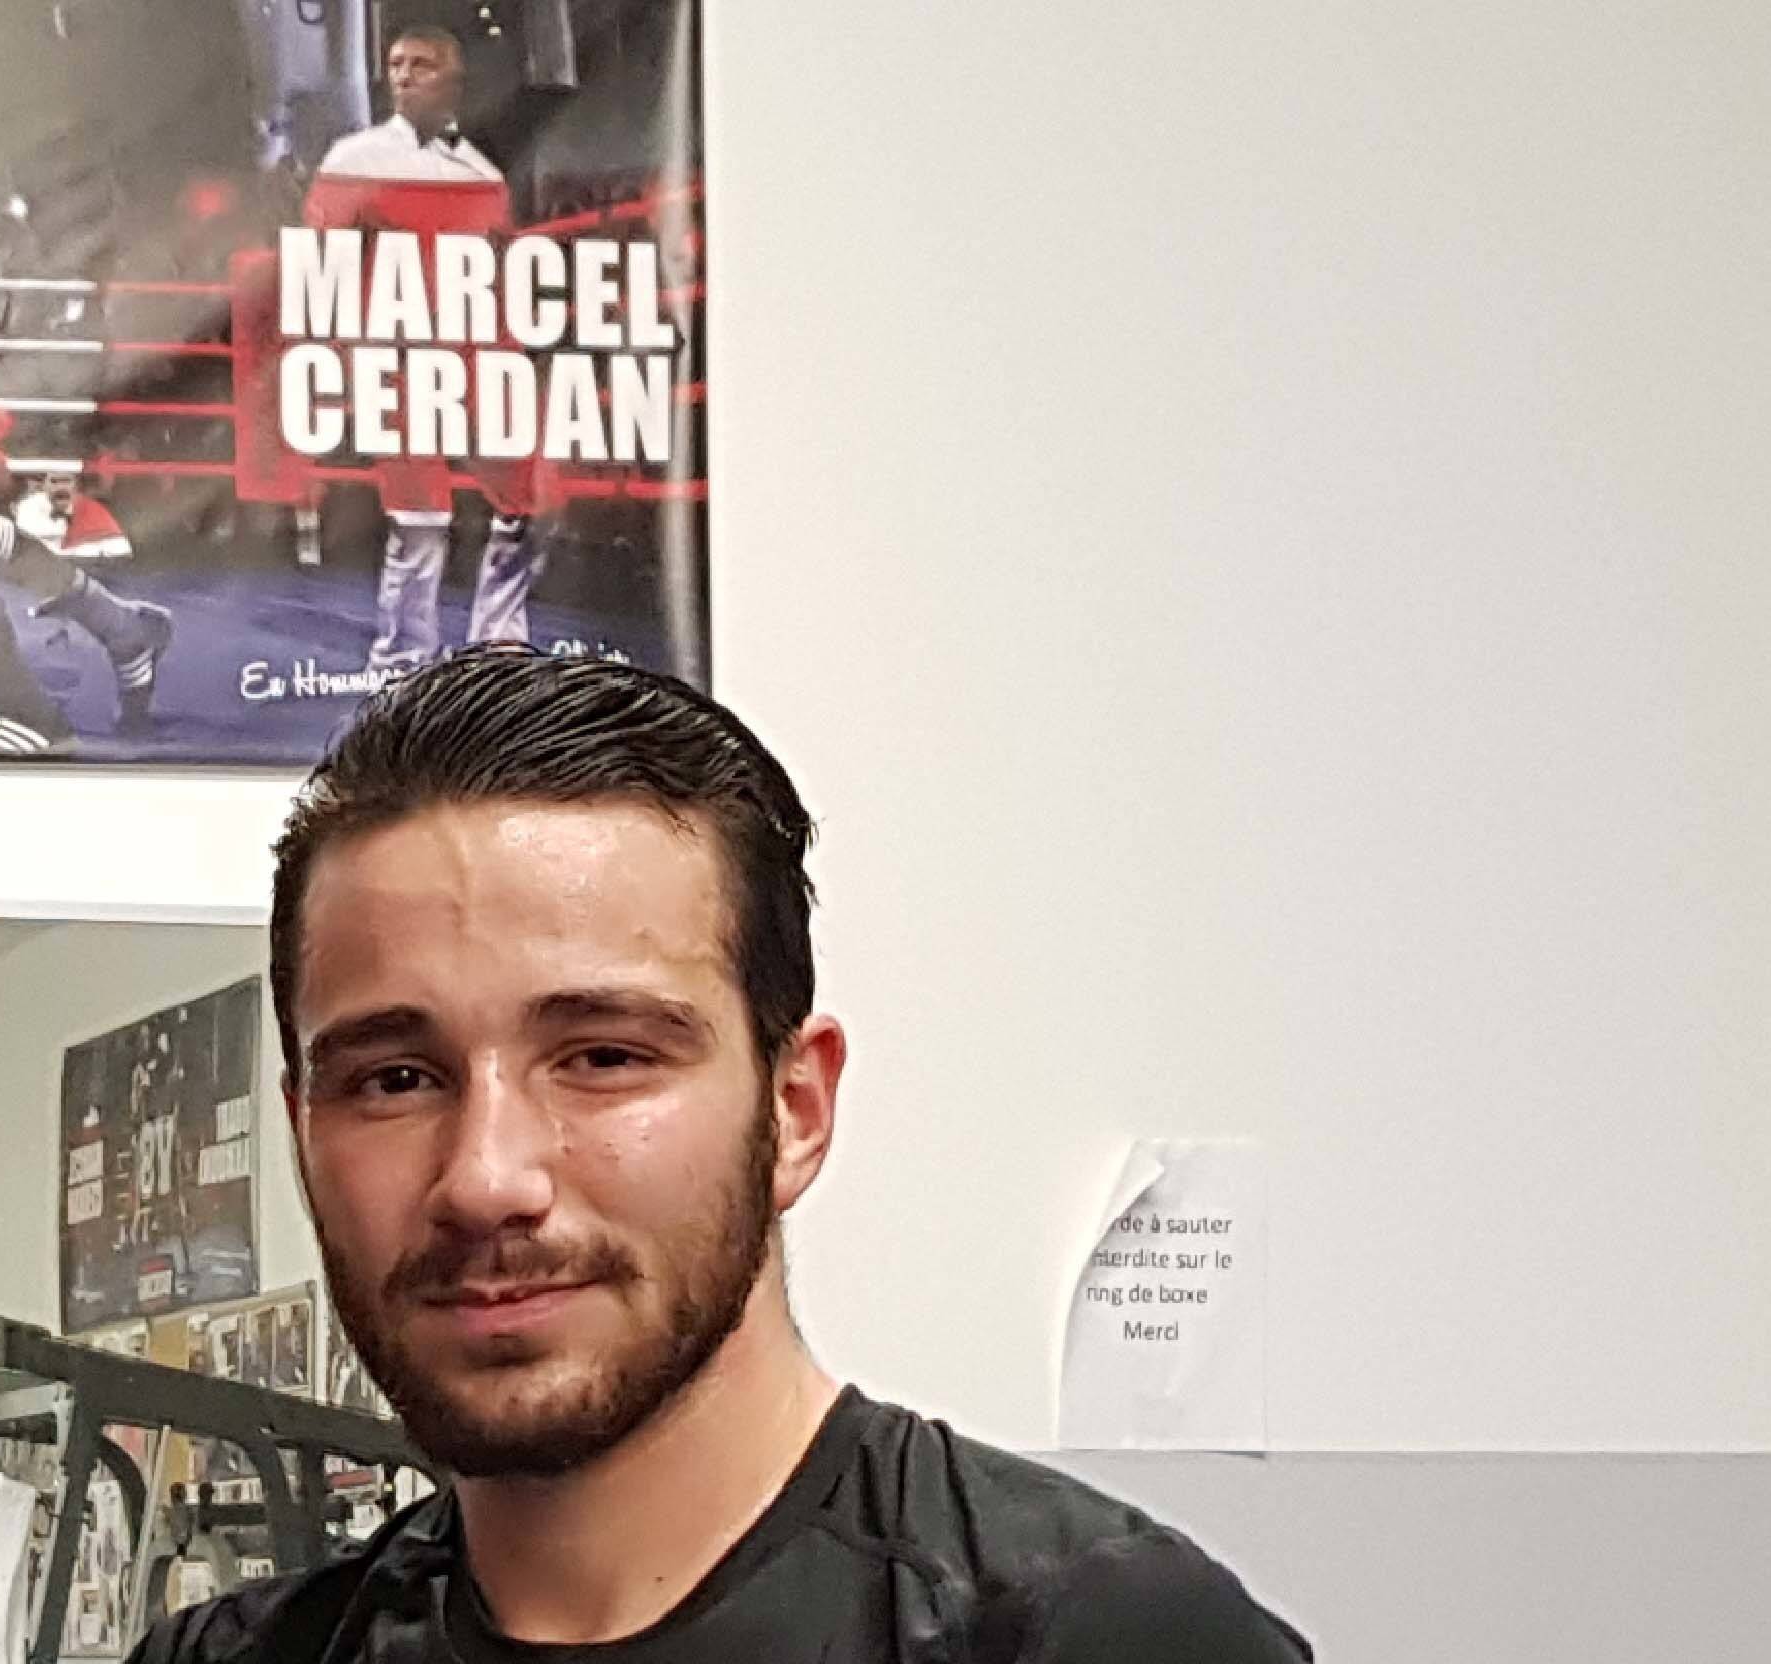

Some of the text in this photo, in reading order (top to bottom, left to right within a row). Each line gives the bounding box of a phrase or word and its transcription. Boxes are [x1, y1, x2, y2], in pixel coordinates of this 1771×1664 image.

[279, 226, 675, 348] MARCEL
[279, 345, 670, 461] CERDAN
[240, 659, 286, 699] En
[1167, 1217, 1232, 1234] sauter
[1177, 1254, 1208, 1269] sur
[1214, 1250, 1233, 1269] le
[1086, 1283, 1209, 1306] ring de boxe
[1123, 1320, 1180, 1342] Merci
